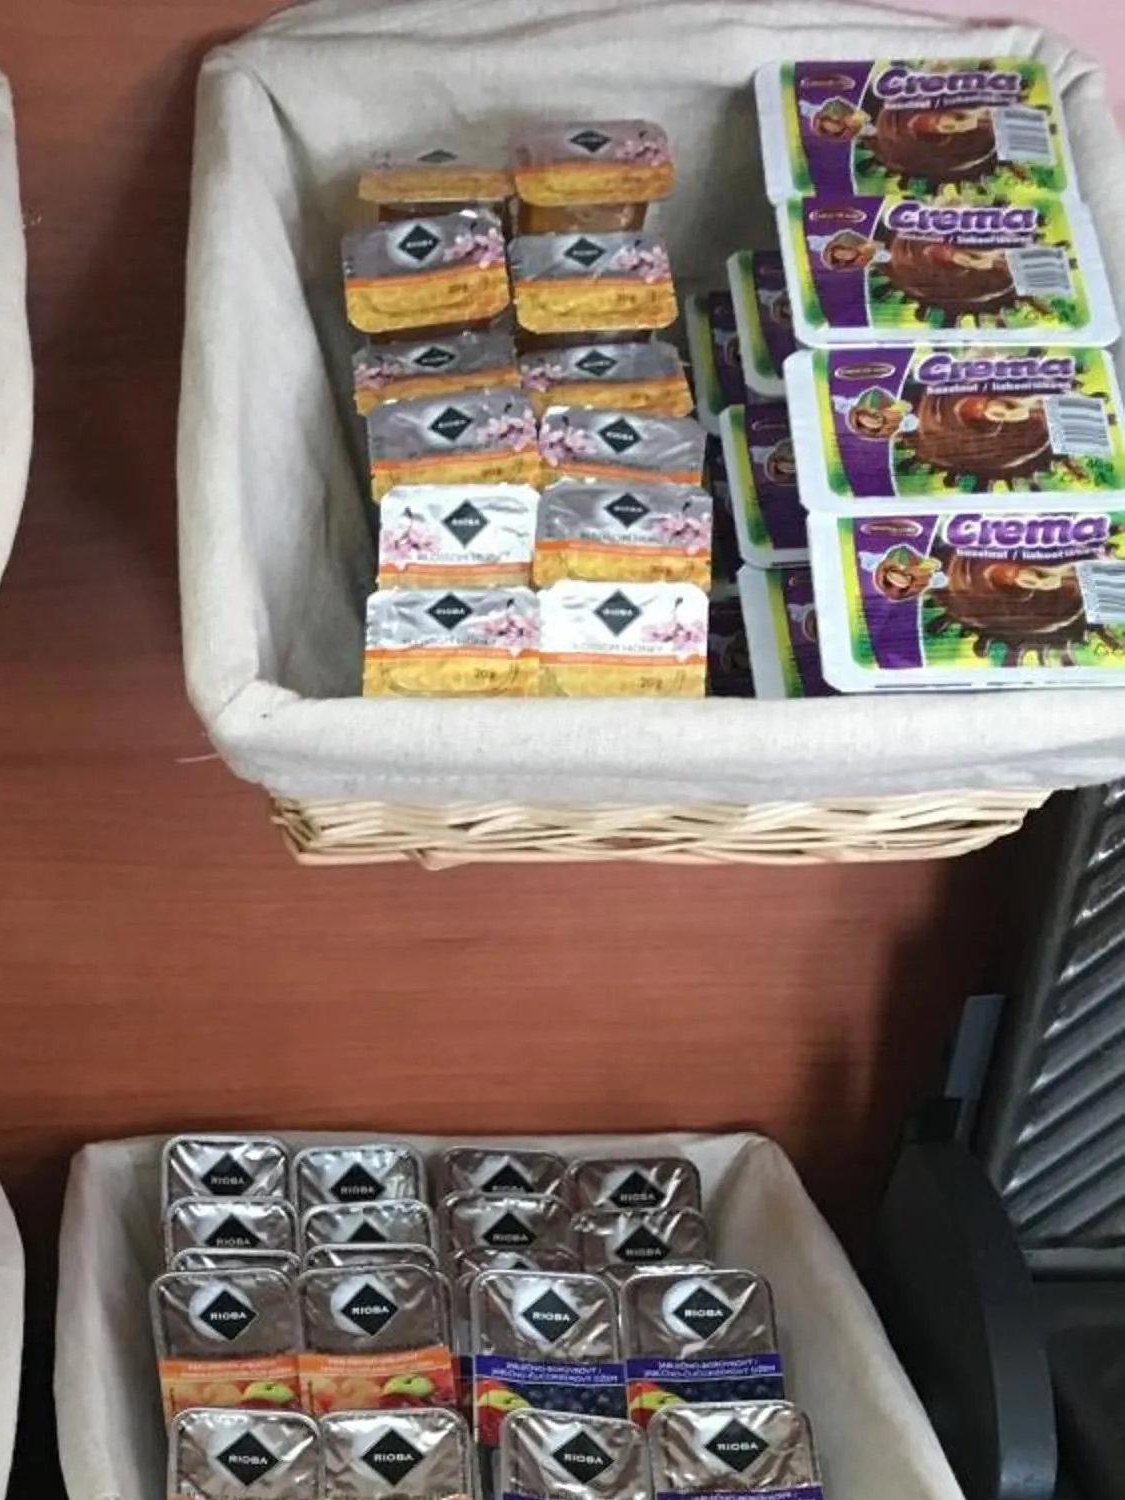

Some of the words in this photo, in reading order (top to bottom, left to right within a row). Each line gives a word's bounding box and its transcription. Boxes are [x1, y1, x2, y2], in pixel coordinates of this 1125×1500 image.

[877, 67, 1020, 97] Crema
[888, 204, 1035, 230] Crema
[918, 356, 1073, 382] Crema
[946, 514, 1109, 546] Crema
[210, 1176, 245, 1185] RIOBA
[340, 1185, 375, 1195] RIOBA
[620, 1193, 658, 1202] RIOBA
[216, 1237, 251, 1246] RIOBA
[492, 1232, 529, 1242] RIOBA
[625, 1247, 662, 1257] RIOBA
[351, 1306, 389, 1315] RIOBA
[684, 1307, 724, 1317] RIOBA
[210, 1311, 247, 1321] RIOBA
[532, 1311, 571, 1322] RIOBA
[716, 1441, 758, 1451] RIOBA
[228, 1455, 268, 1465] RIOBA
[374, 1453, 414, 1462] RIOBA
[563, 1453, 604, 1465] RIOBA
